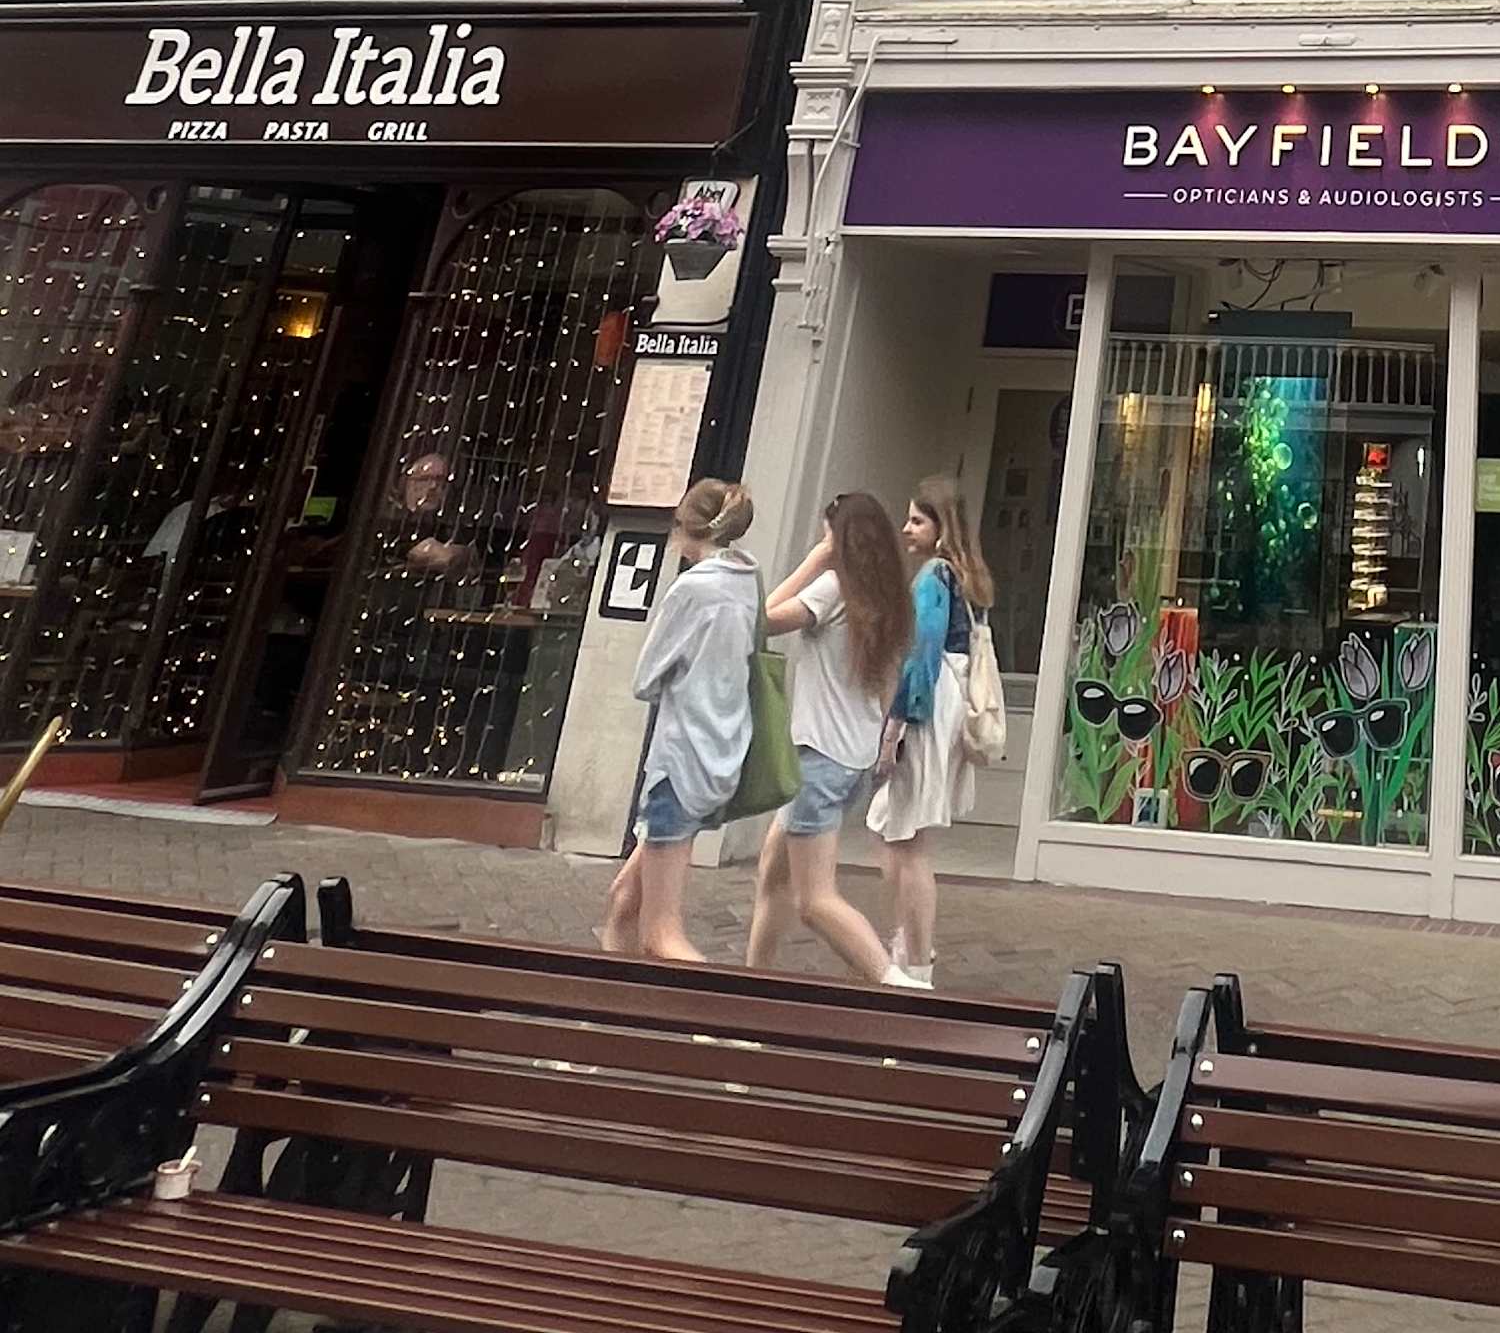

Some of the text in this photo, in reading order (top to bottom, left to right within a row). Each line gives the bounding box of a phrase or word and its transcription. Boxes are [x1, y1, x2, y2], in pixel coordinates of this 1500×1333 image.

[124, 22, 505, 106] Bella Italia
[168, 121, 428, 141] PIZZA PASTA GRILL
[1172, 187, 1484, 208] OPTICIANS & AUDIOLOGISTS
[635, 333, 719, 355] Bella Italia
